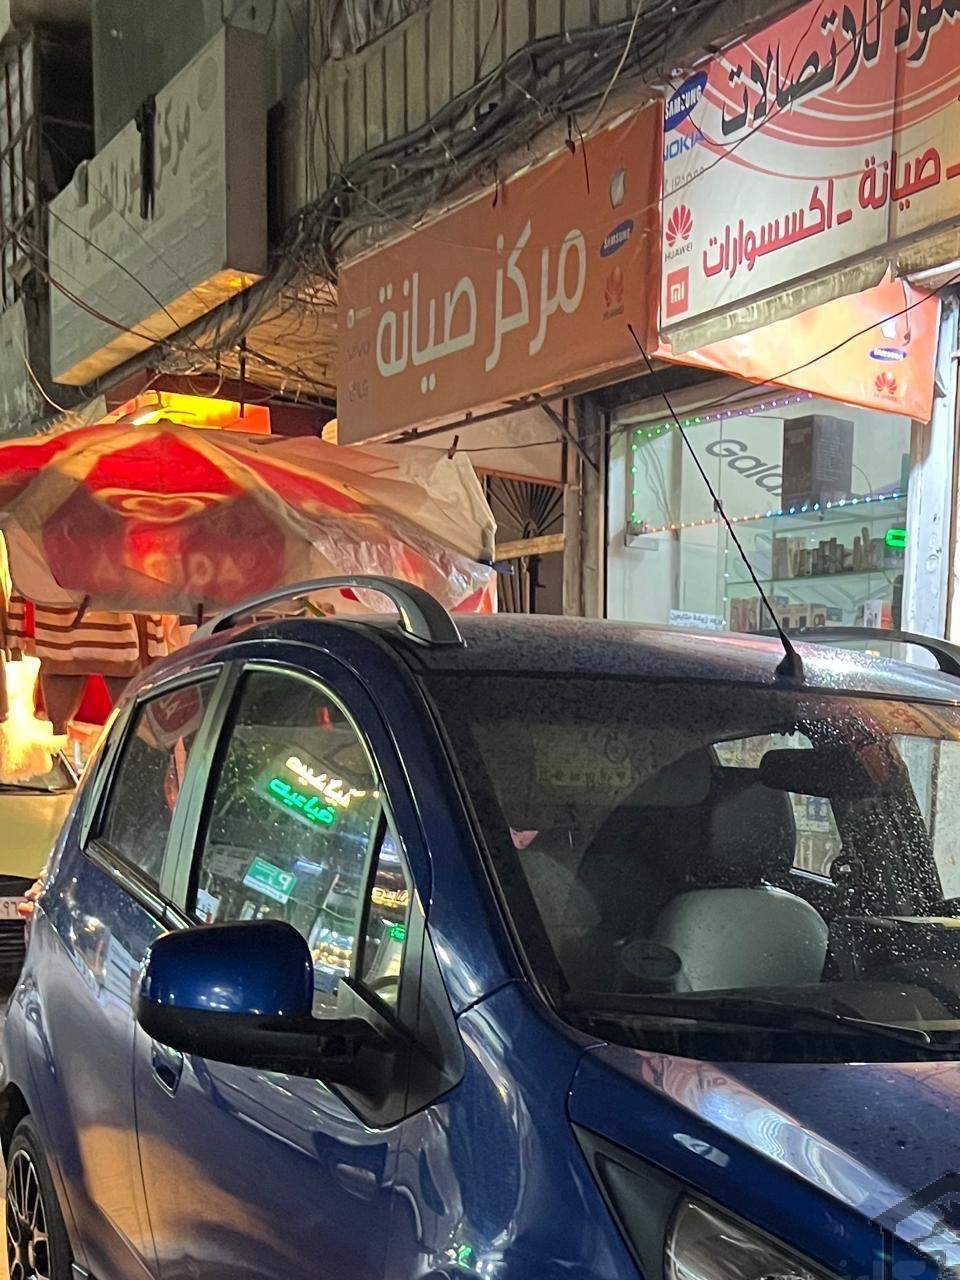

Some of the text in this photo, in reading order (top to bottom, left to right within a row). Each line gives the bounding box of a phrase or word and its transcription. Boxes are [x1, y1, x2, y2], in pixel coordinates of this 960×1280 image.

[664, 85, 702, 121] SAMSUNG
[856, 147, 941, 211] صيانة
[664, 242, 693, 263] HUAWEI
[702, 179, 833, 279] اكسسوارات
[376, 219, 587, 394] مركز صيانة
